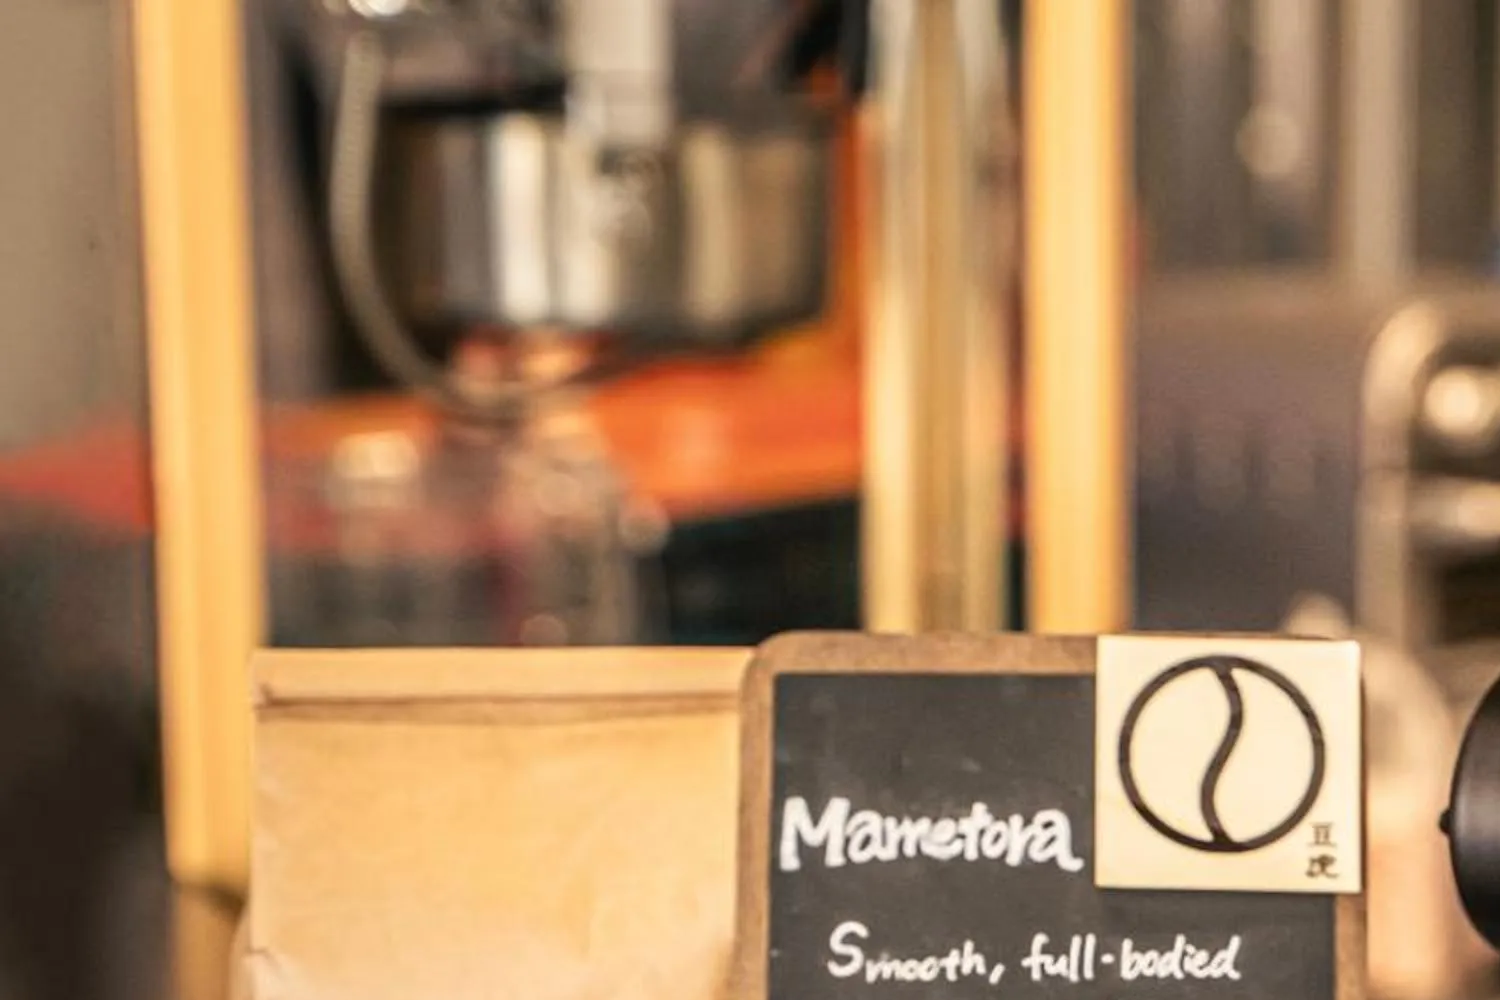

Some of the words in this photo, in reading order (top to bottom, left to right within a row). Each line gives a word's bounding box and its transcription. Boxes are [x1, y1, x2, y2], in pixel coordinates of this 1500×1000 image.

[779, 797, 1084, 872] Mametora
[827, 920, 1005, 985] Smooth,
[1021, 932, 1242, 983] full-bodied
